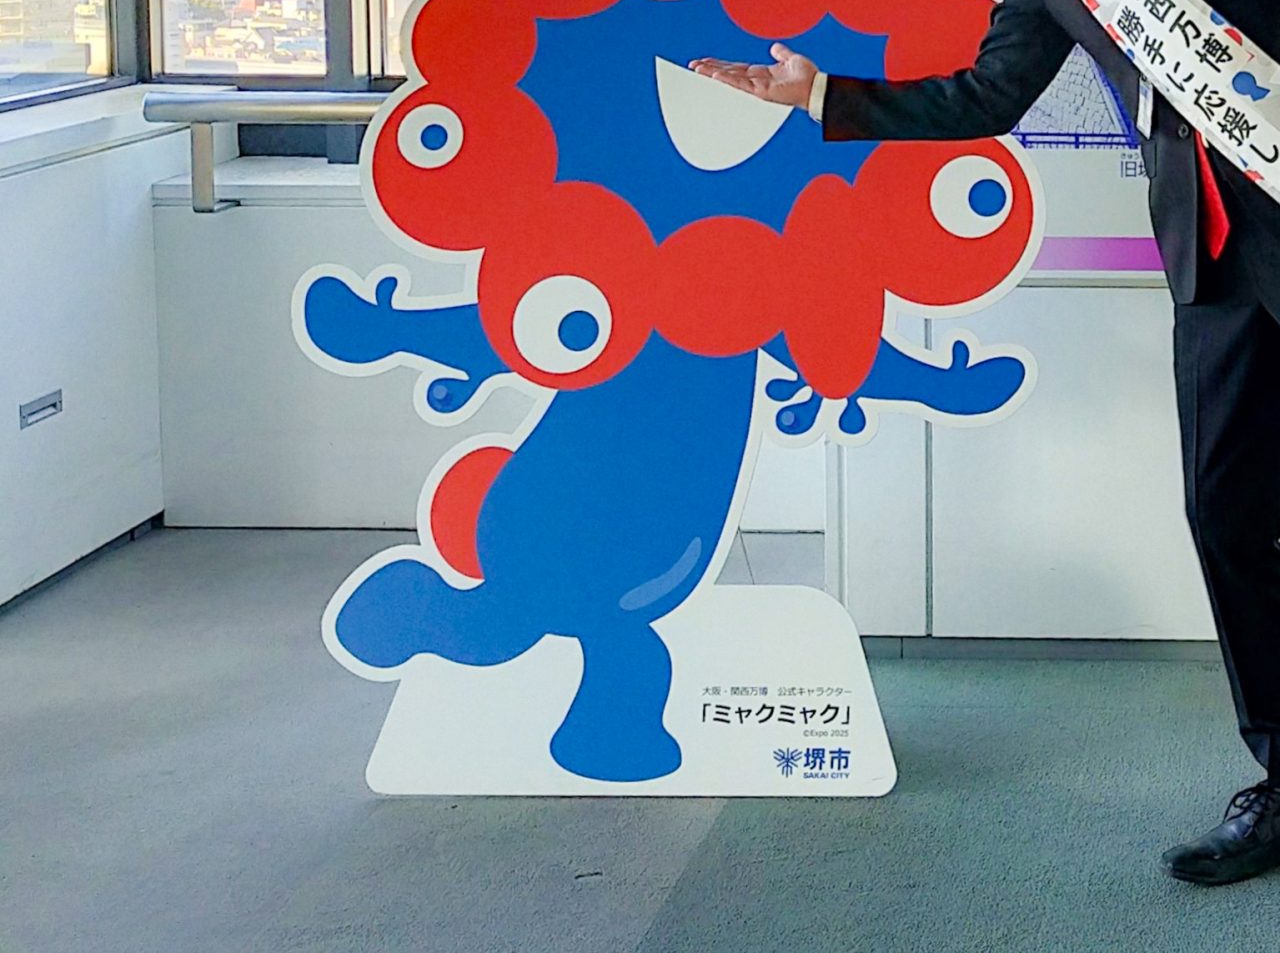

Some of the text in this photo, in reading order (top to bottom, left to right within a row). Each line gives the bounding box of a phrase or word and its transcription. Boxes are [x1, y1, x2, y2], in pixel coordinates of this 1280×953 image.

[702, 686, 852, 696] 大阪・関西万博 公式キャラクター
[701, 703, 851, 725] 「ミャクミャク」
[804, 748, 851, 771] 堺市
